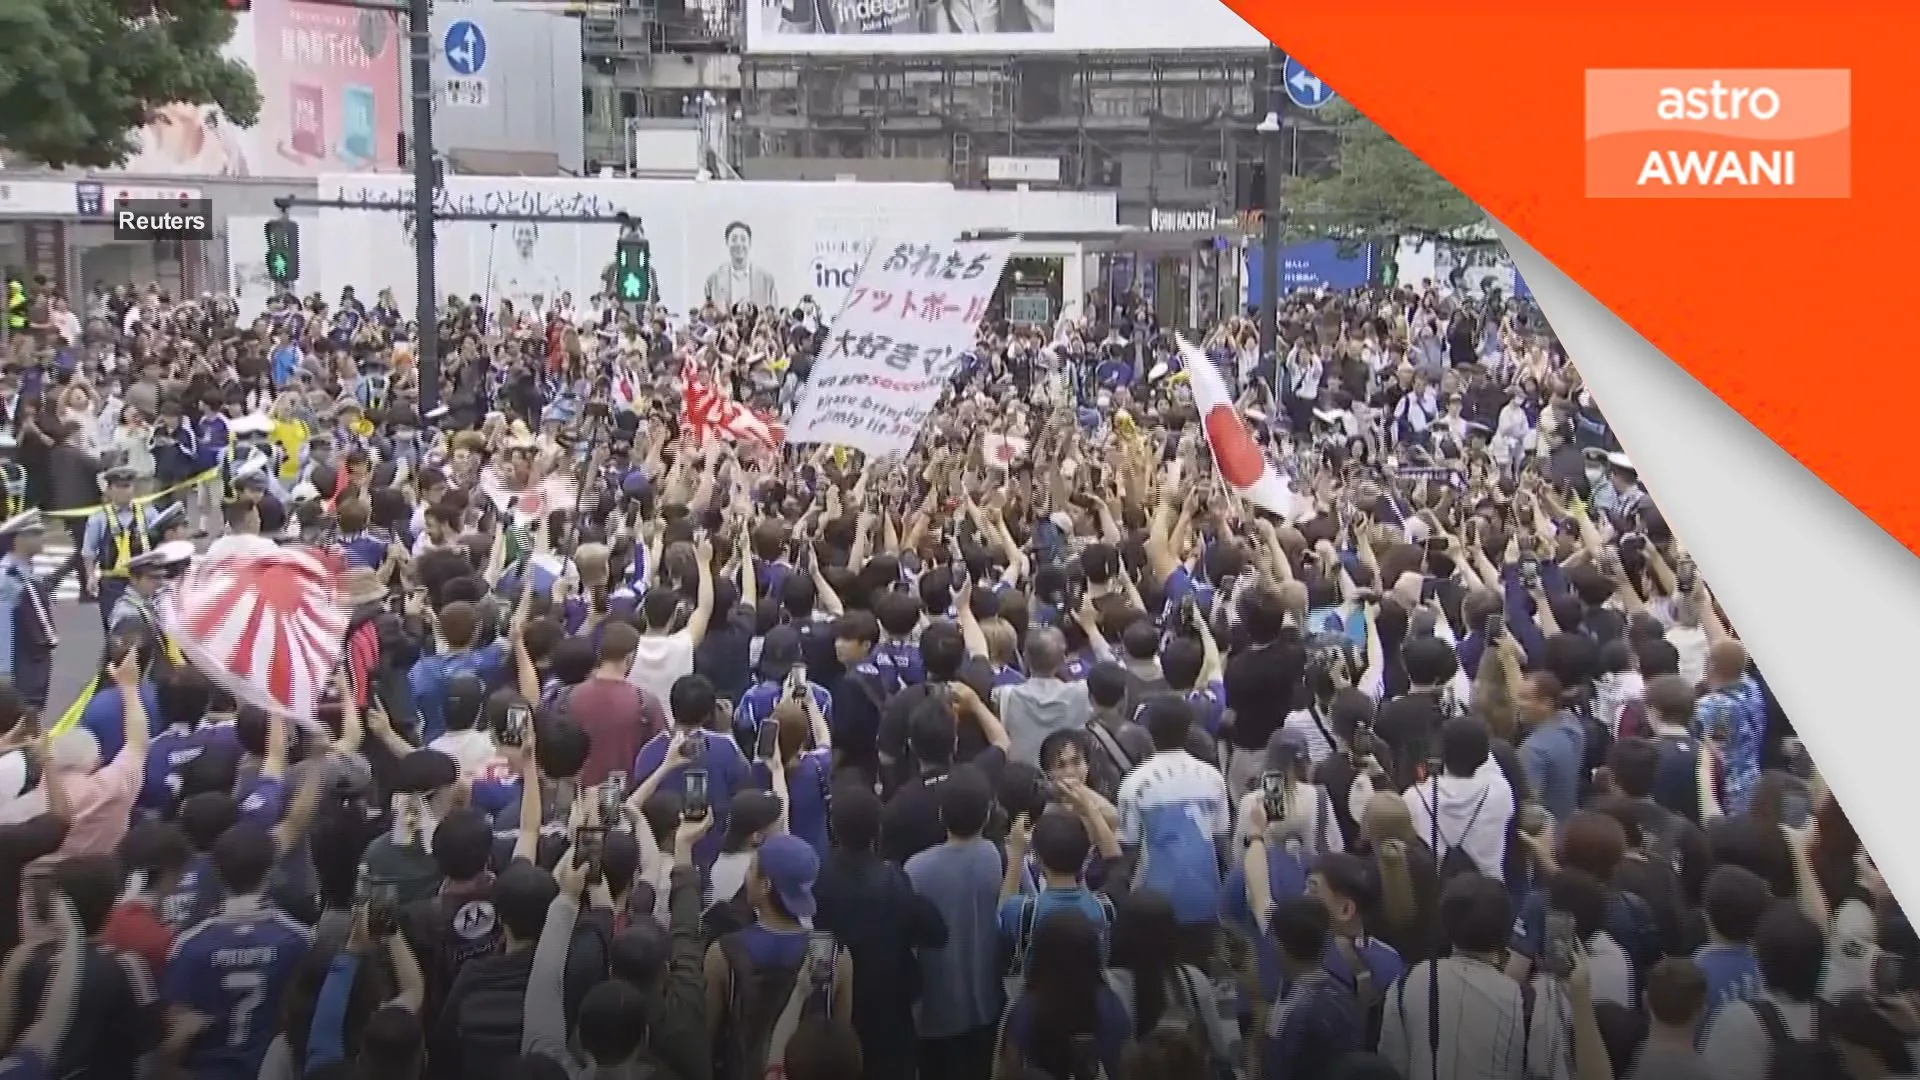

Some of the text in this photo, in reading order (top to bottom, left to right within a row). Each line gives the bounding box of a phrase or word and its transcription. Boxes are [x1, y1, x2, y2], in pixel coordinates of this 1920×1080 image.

[882, 243, 991, 279] おれたち
[221, 971, 268, 1047] 7
